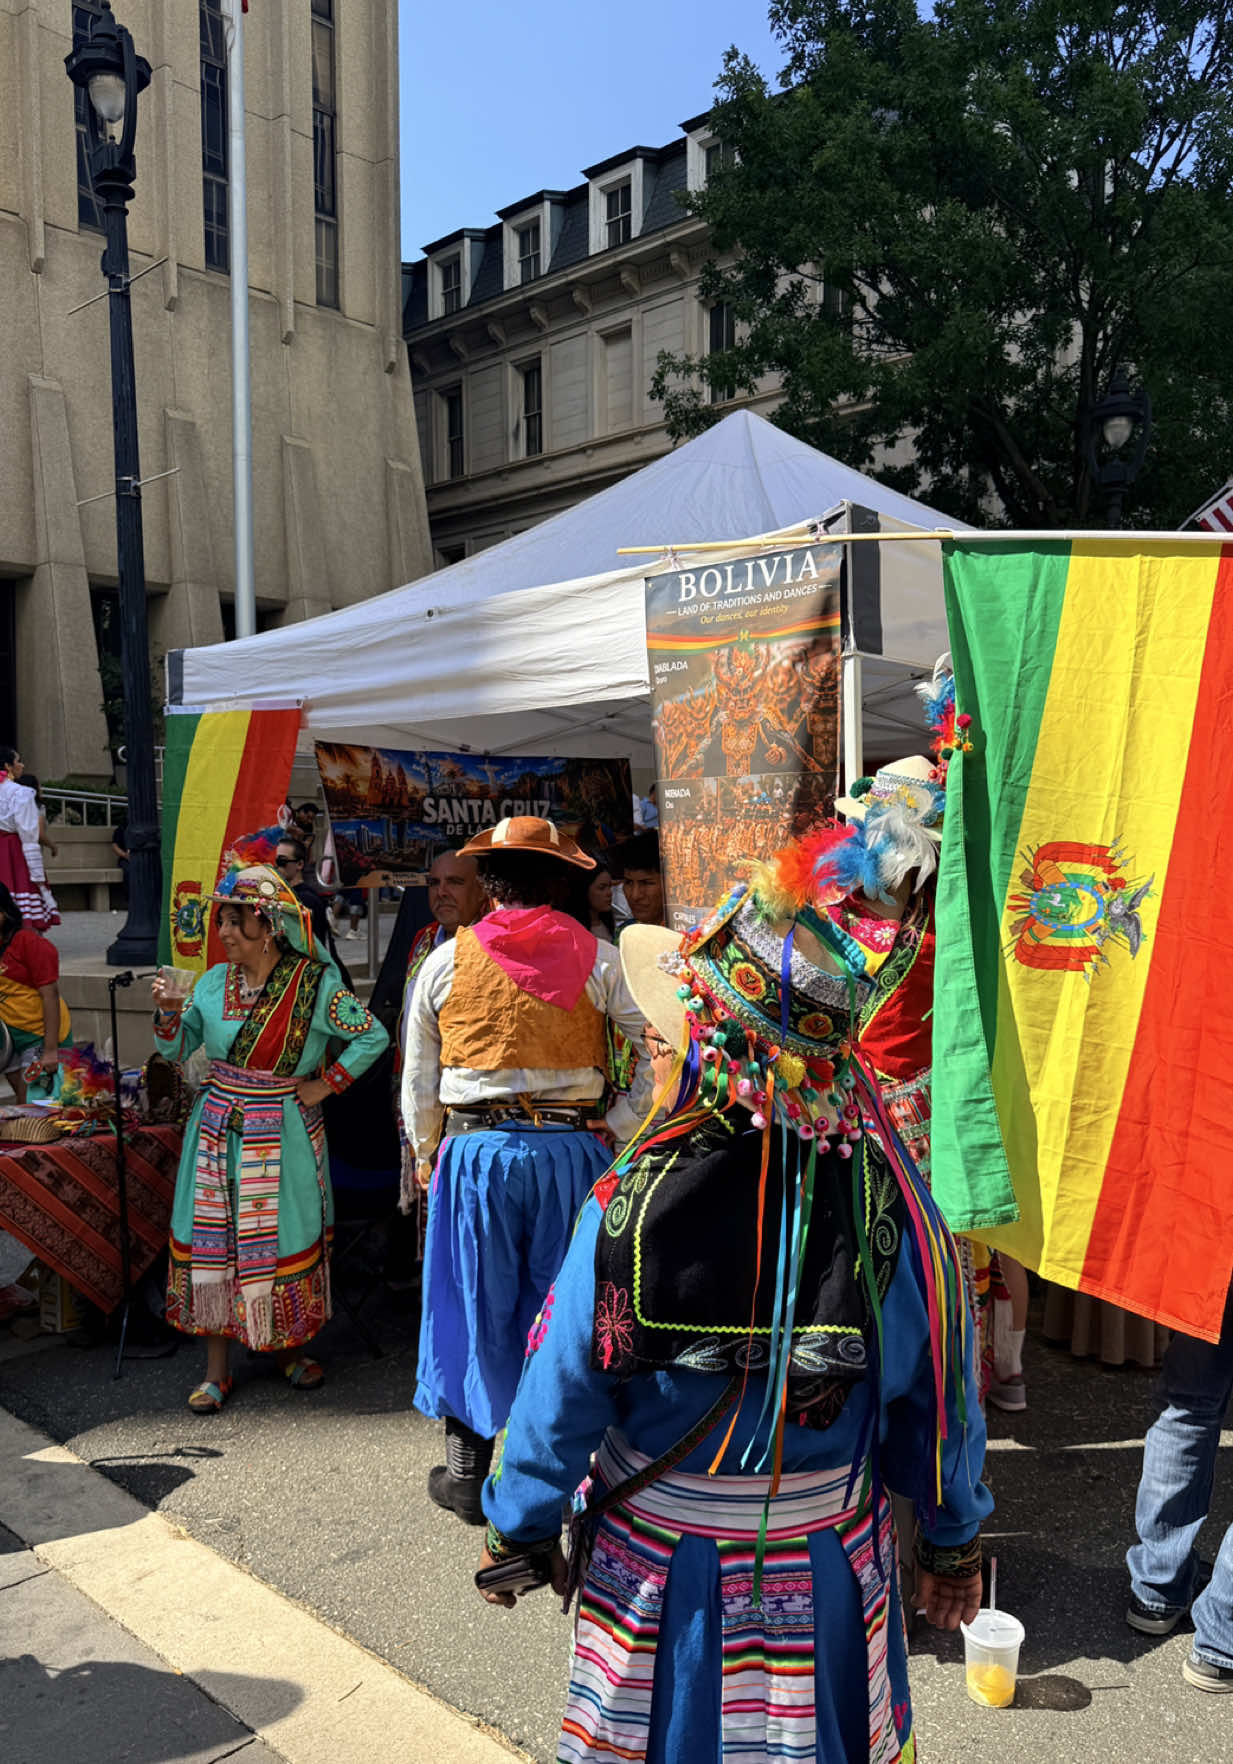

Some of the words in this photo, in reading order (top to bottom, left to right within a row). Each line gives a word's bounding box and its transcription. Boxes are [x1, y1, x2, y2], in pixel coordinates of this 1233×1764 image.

[678, 550, 820, 603] BOLIVIA
[677, 604, 699, 617] LAND
[699, 601, 712, 613] OF
[712, 593, 763, 610] TRADITIONS
[763, 590, 783, 603] AND
[783, 583, 818, 599] DANCES
[422, 797, 497, 824] SANTA
[500, 798, 551, 822] CRUZ
[446, 823, 464, 836] DE
